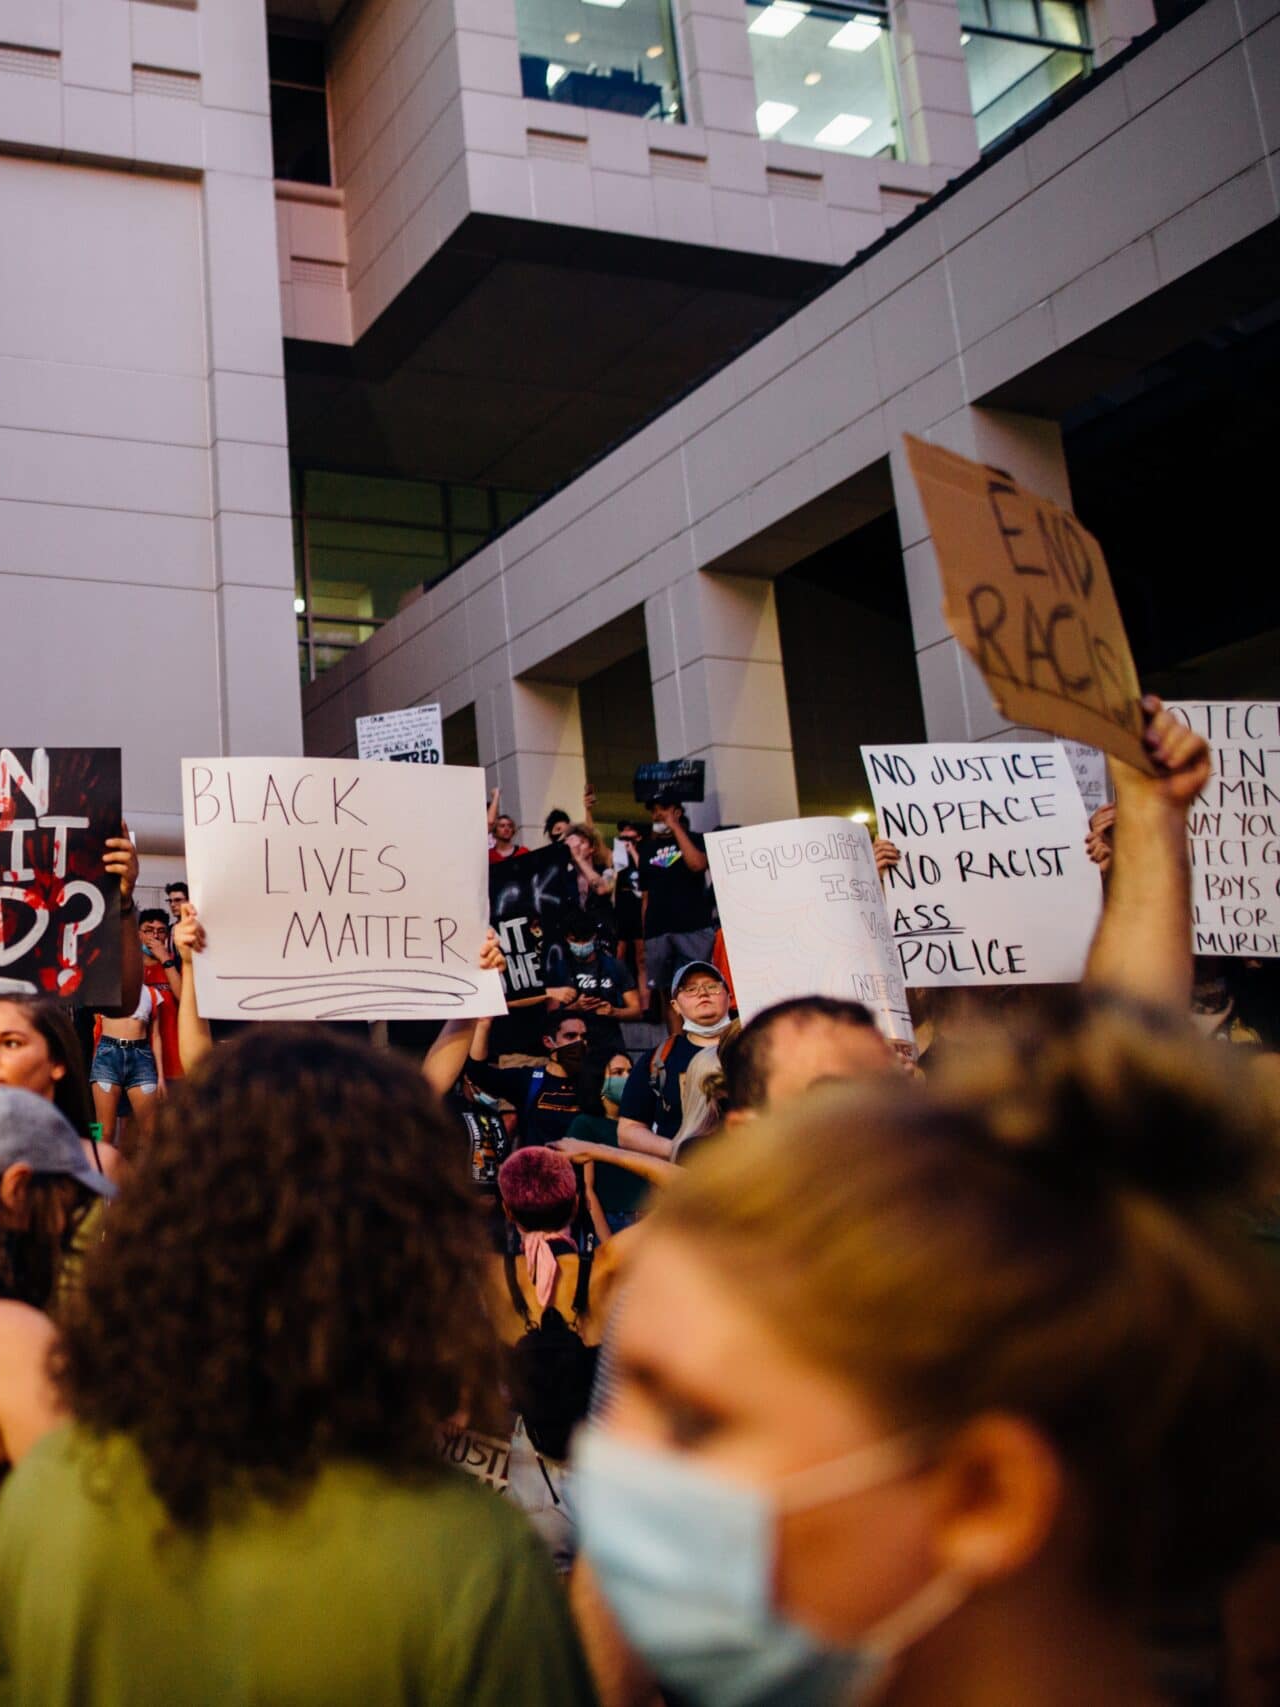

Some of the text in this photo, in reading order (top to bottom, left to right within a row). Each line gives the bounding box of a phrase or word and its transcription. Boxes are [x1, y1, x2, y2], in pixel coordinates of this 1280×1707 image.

[983, 464, 1094, 598] END
[384, 743, 409, 753] BLACK
[414, 738, 433, 749] AND
[869, 753, 1057, 787] NO JUSTICE
[191, 766, 368, 826] BLACK
[882, 793, 1057, 839] NO PEACE
[264, 837, 407, 896] LIVES
[888, 845, 1071, 890] NO RACIST
[1205, 873, 1261, 901] BOYS
[282, 911, 469, 964] MATTER
[893, 904, 952, 932] ASS
[1220, 905, 1274, 927] FOR
[896, 938, 1027, 981] POLICE
